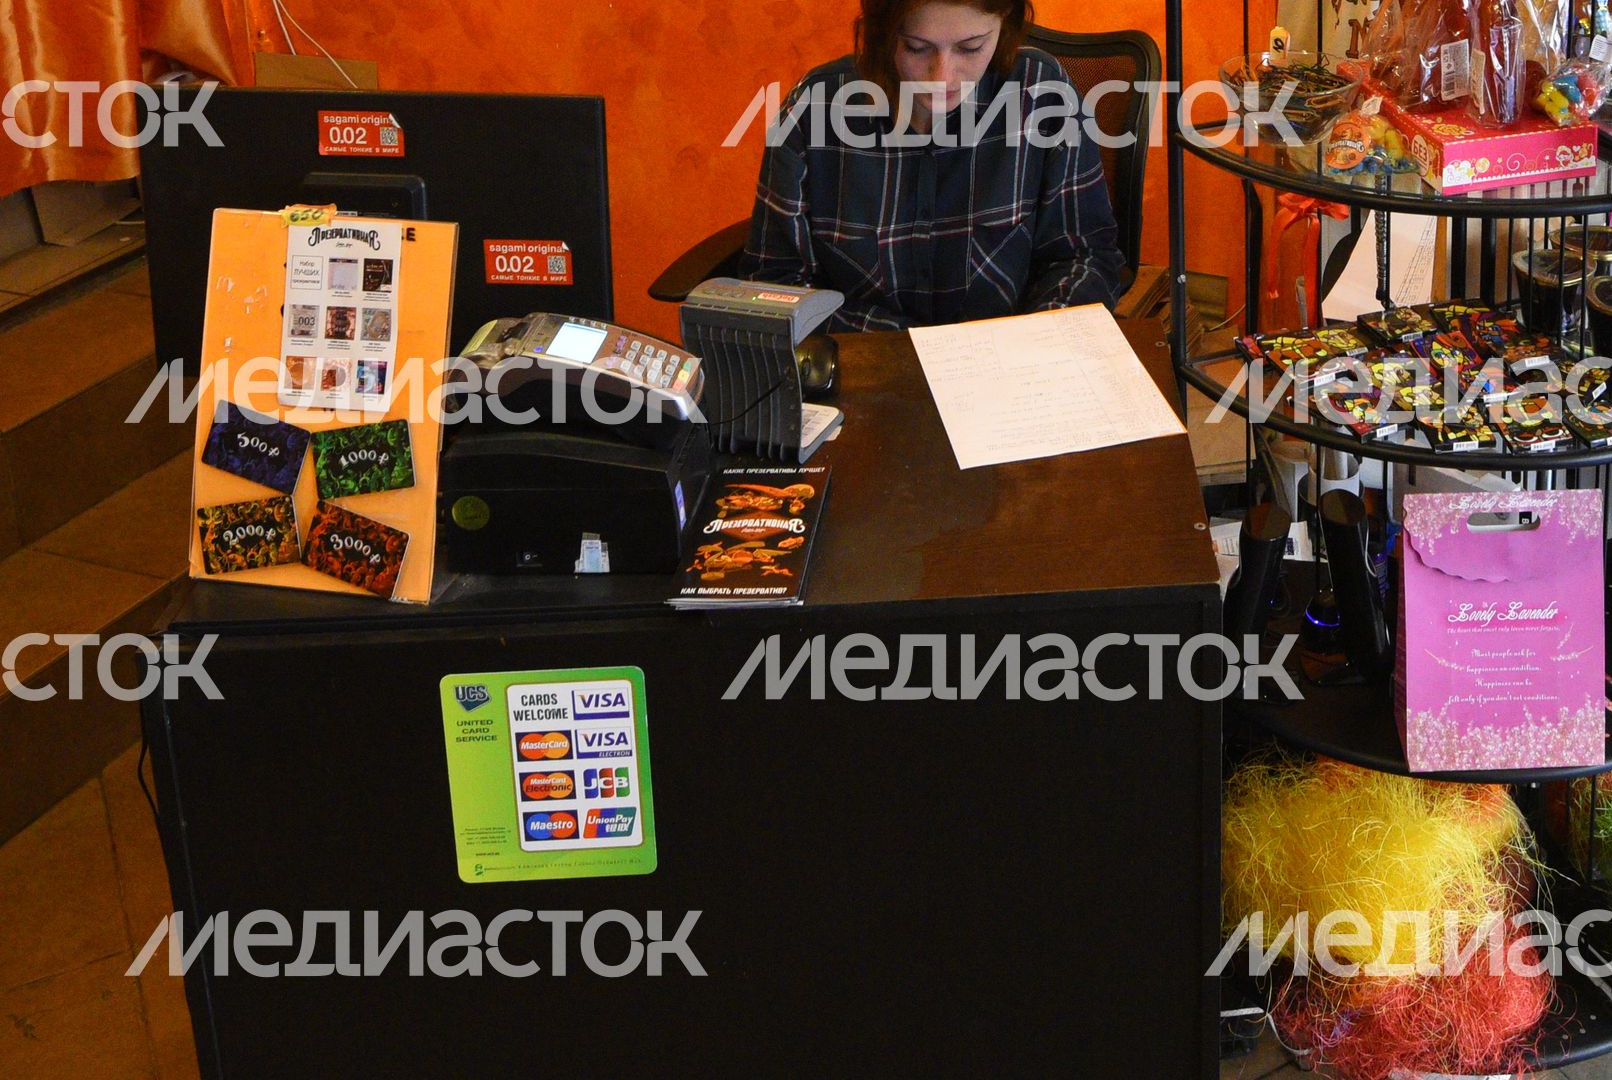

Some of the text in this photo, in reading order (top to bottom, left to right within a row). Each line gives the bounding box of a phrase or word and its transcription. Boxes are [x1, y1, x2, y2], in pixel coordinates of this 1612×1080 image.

[323, 115, 360, 126] sagami
[328, 126, 368, 145] 0.02
[488, 243, 527, 254] sagami
[494, 255, 535, 274] 0.02
[703, 518, 806, 534] ПРЕЗЕРВАТИВНАЯ
[680, 586, 788, 595] КАК ВЫБРАТЬ ПРЕЗЕРВАТИВ?
[1448, 601, 1559, 627] Lovely Lavender
[454, 684, 490, 701] UCS
[520, 693, 558, 707] CARDS
[579, 692, 627, 709] VISA
[512, 707, 569, 722] WELCOME
[456, 719, 494, 727] UNITED
[455, 734, 498, 743] SERVICE
[521, 739, 570, 751] MasterCard
[583, 731, 629, 748] VISA
[598, 749, 632, 758] ELECTRON
[525, 781, 573, 793] Electronic
[529, 776, 567, 785] MasterCard
[584, 776, 630, 790] JCB
[530, 819, 574, 831] Maestro
[587, 813, 634, 826] UnionPay
